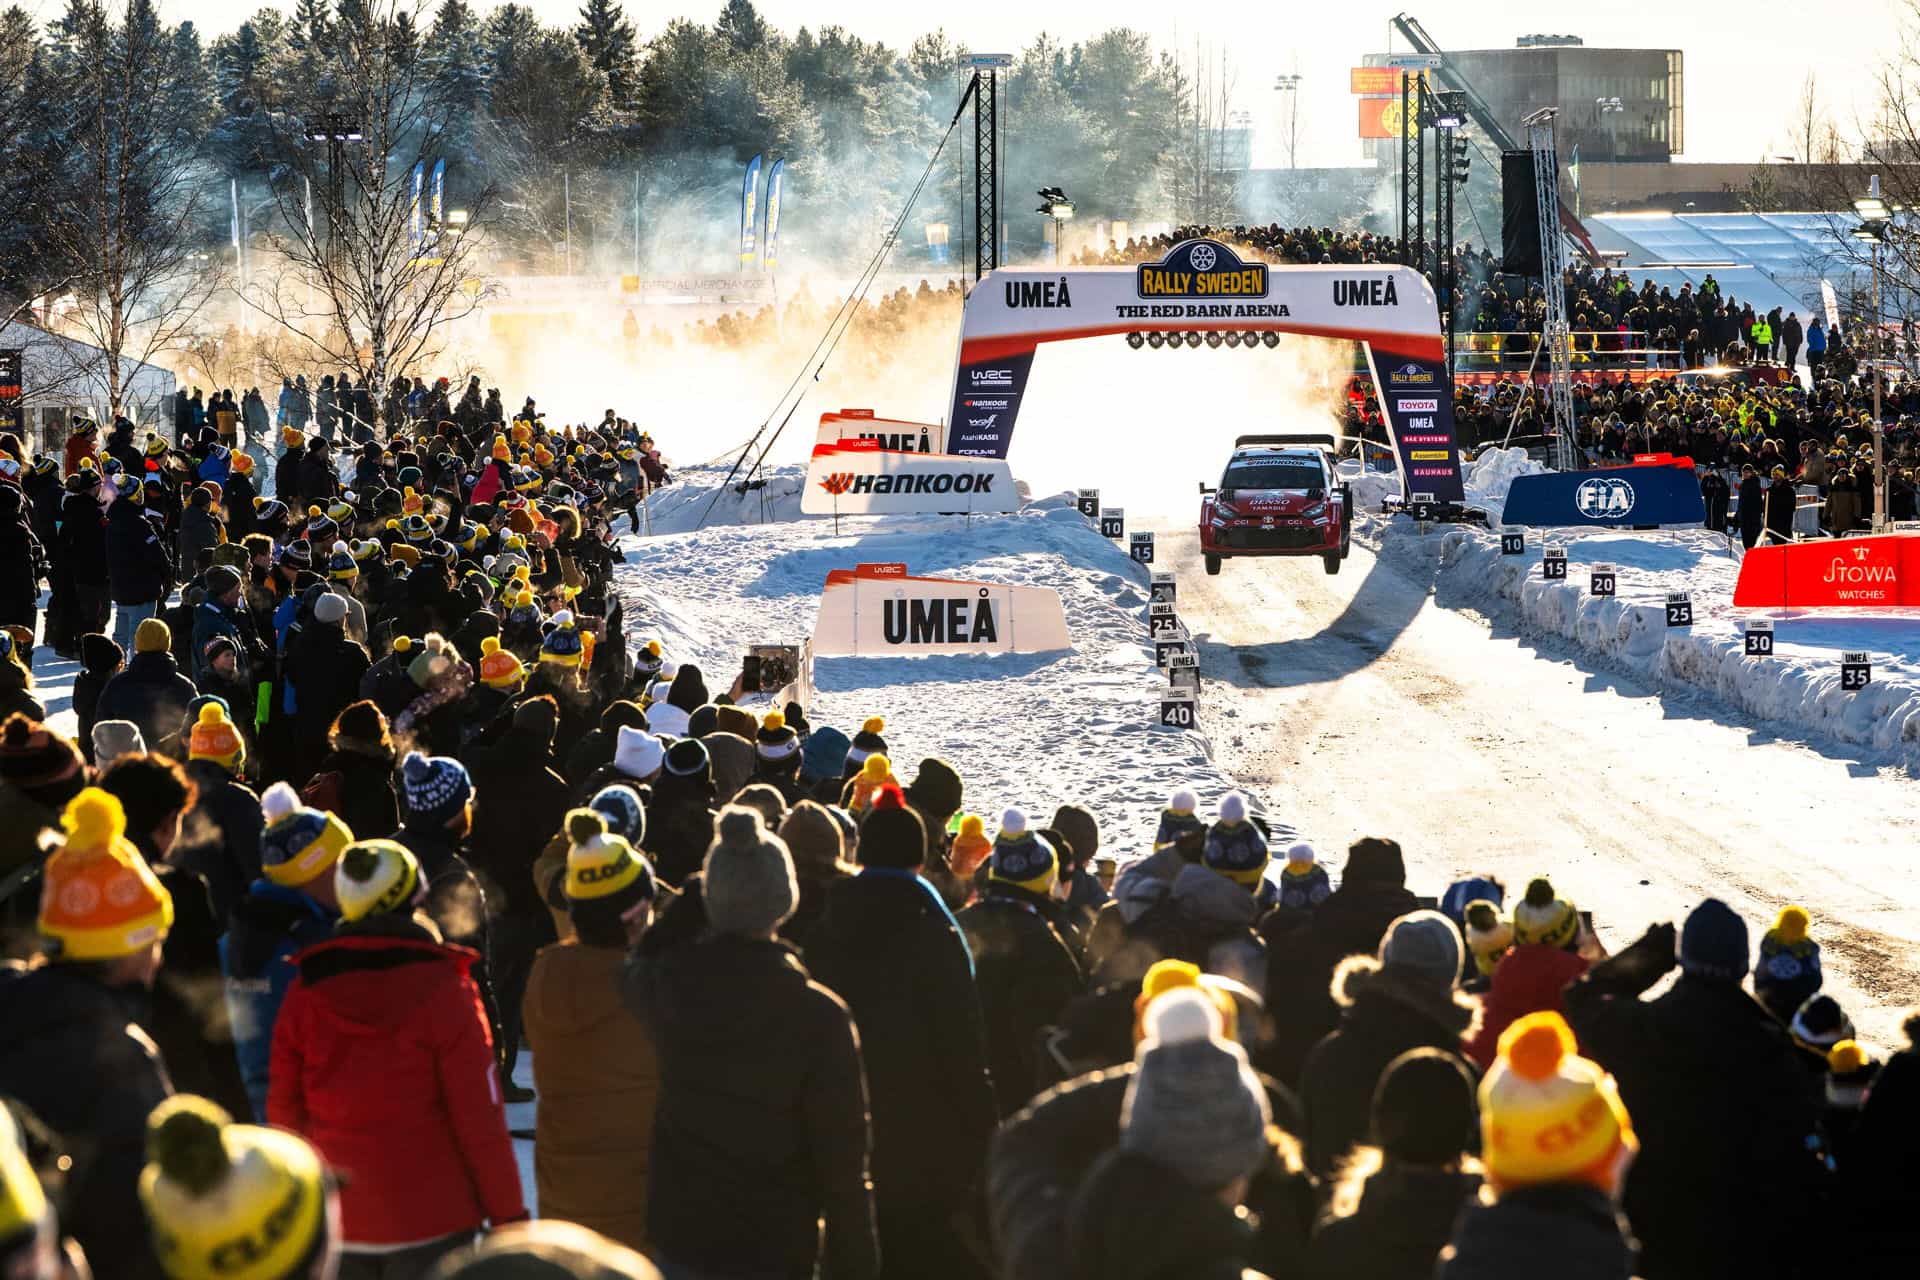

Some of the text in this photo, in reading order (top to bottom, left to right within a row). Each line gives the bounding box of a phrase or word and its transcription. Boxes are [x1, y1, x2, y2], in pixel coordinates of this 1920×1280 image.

[1143, 269, 1263, 294] RALLY SWEDEN
[1005, 276, 1072, 308] UMEÅ
[1333, 274, 1399, 306] UMEÅ
[1116, 304, 1290, 318] THE RED BARN ARENA
[971, 369, 1013, 380] WRC
[1409, 416, 1434, 429] UMEÅ
[1413, 468, 1453, 476] BAUHAUS
[1085, 502, 1093, 513] 5
[1420, 506, 1428, 517] 5
[1104, 522, 1121, 534] 10
[1504, 539, 1521, 551] 10
[1134, 547, 1151, 560] 15
[873, 566, 902, 574] WRC
[1547, 562, 1564, 575] 15
[1594, 578, 1613, 592] 20
[1837, 590, 1886, 600] WATCHES
[883, 587, 998, 645] UMEÅ
[1669, 607, 1689, 622] 25
[1748, 635, 1770, 651] 30
[1845, 652, 1868, 662] UMEÅ
[1844, 669, 1868, 685] 35
[1164, 707, 1191, 725] 40
